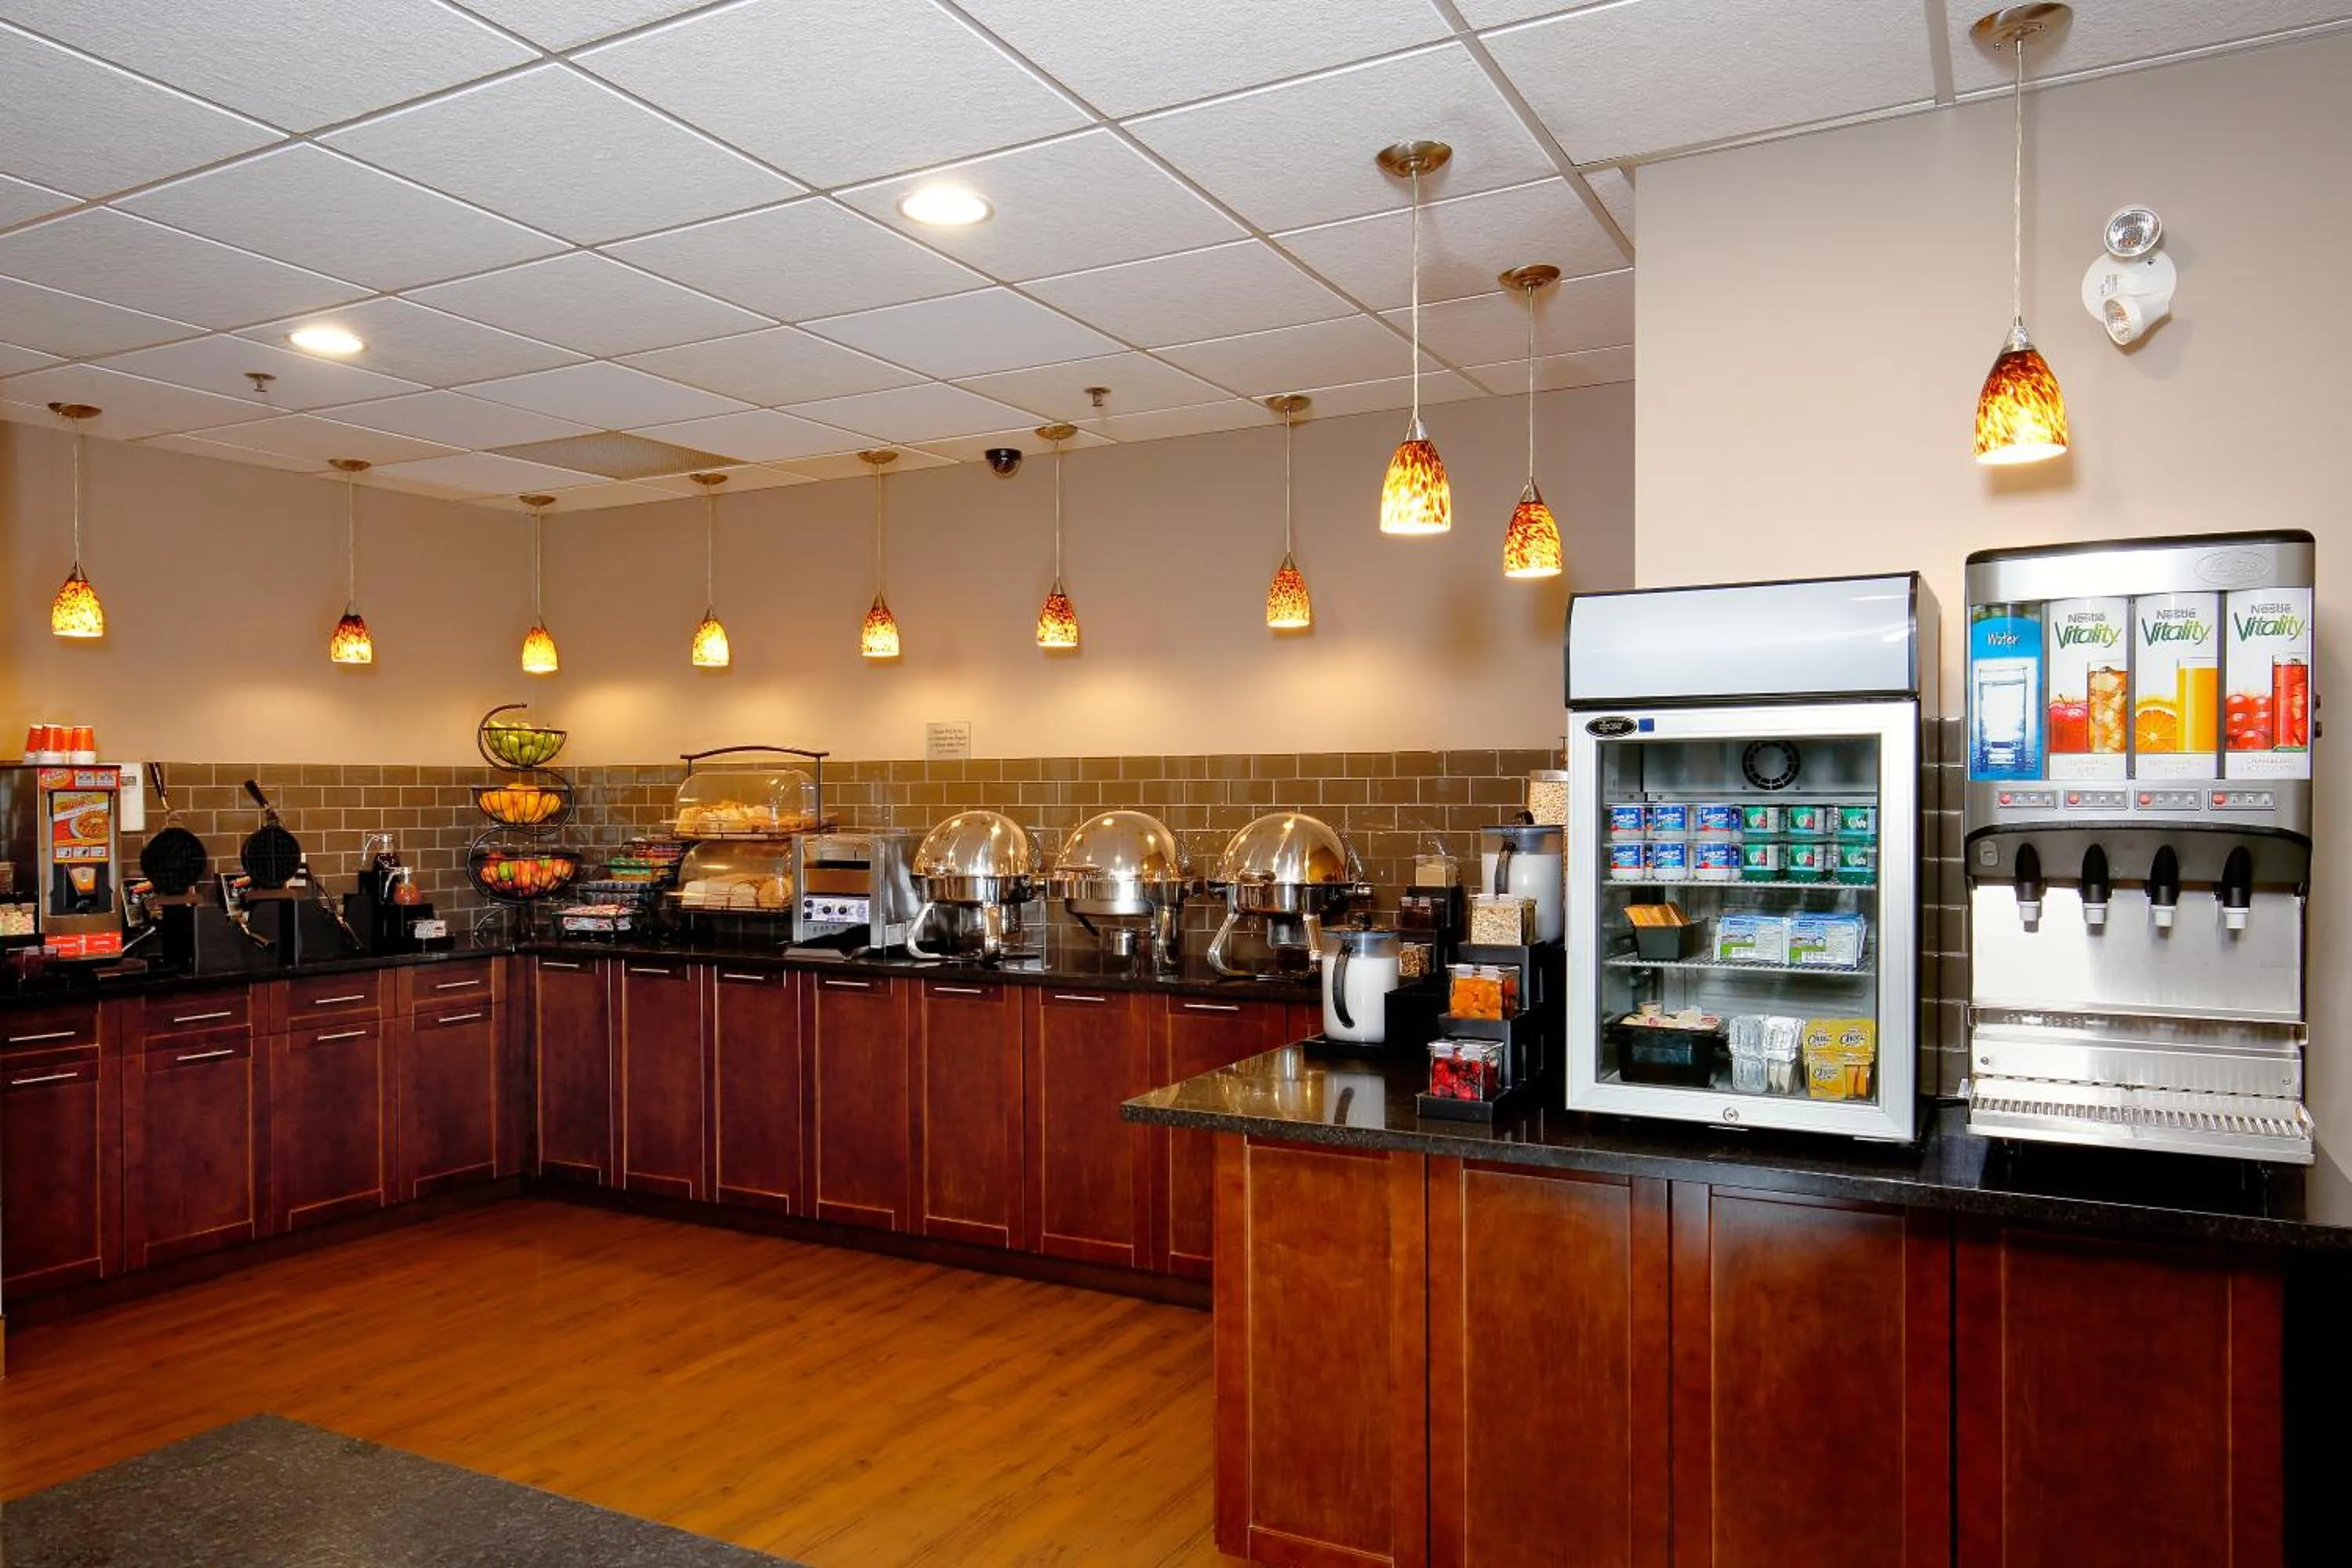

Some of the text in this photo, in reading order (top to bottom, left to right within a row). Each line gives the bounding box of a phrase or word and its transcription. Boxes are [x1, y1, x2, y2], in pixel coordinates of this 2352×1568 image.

[1987, 631, 2019, 645] Water
[2055, 621, 2122, 648] Vitality
[2141, 617, 2212, 646] Vitality
[2234, 611, 2305, 641] Vitality
